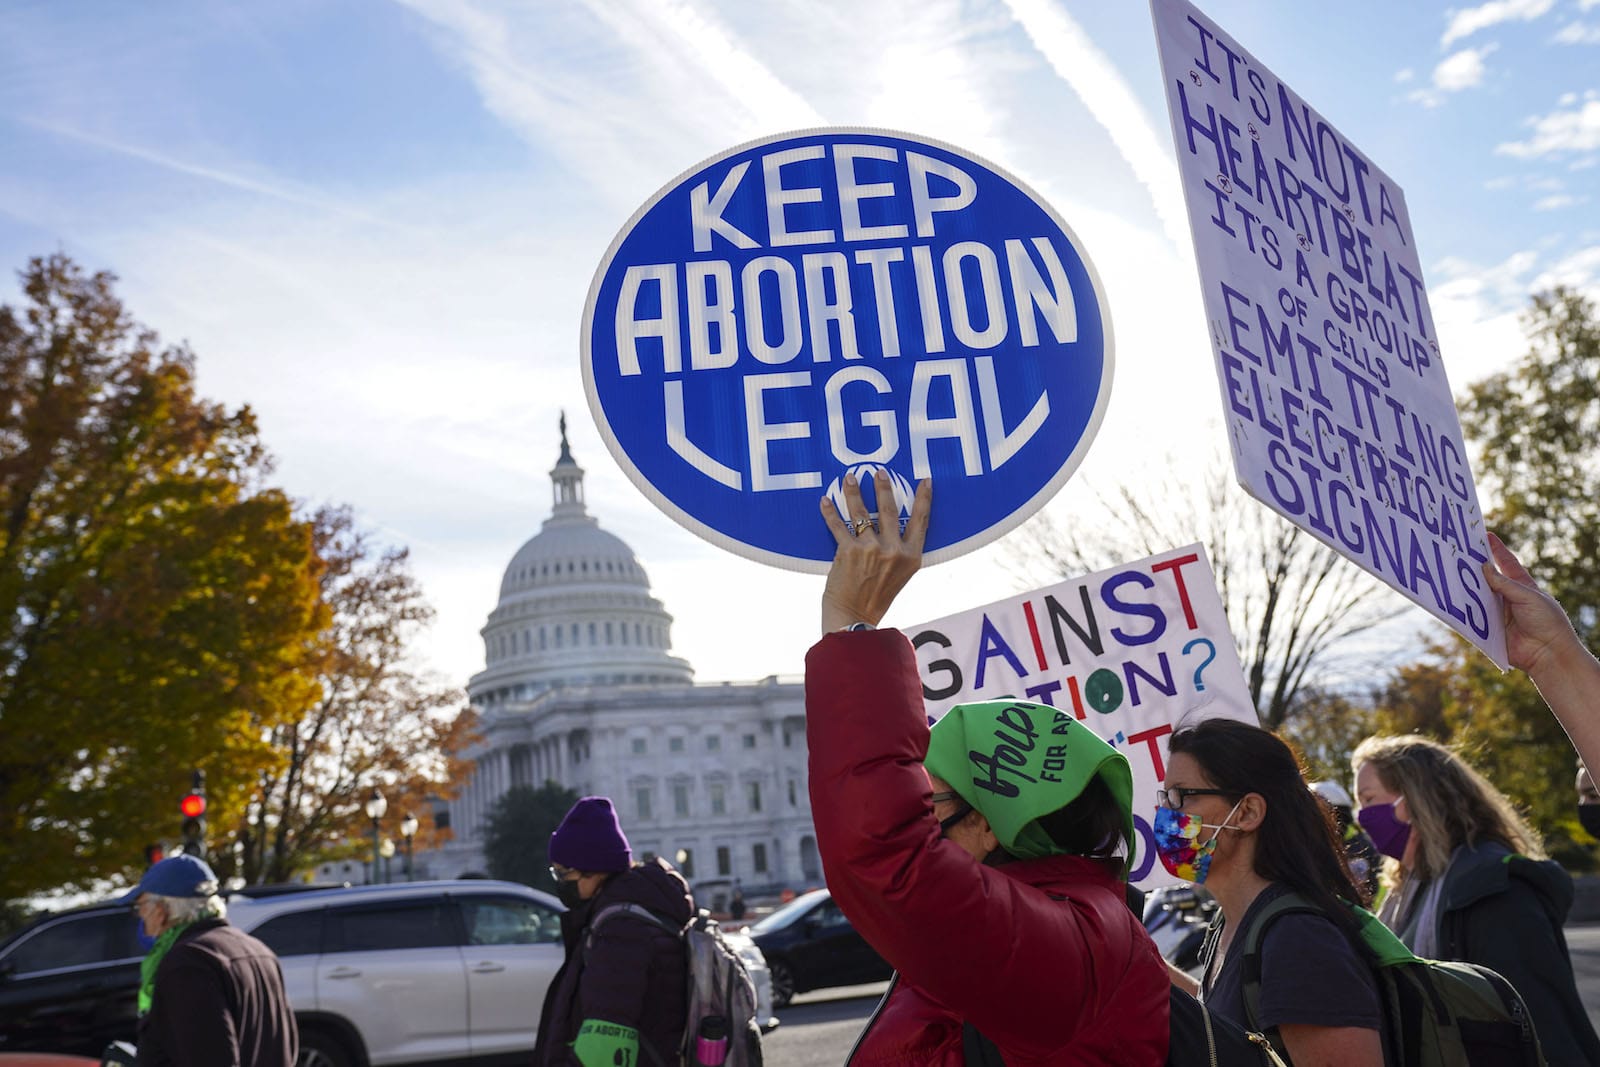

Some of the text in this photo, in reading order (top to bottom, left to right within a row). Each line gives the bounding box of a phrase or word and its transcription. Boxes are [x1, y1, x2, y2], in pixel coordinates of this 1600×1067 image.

[690, 143, 978, 253] KEEP
[1176, 79, 1427, 339] HEARTBEAT
[1187, 15, 1407, 247] IT'S NOT A
[615, 236, 1078, 376] ABORTION
[1203, 178, 1431, 377] IT'S A GROUP
[1278, 287, 1391, 388] OF CELLS
[663, 355, 1051, 493] LEGAL
[1221, 281, 1469, 502] EMITTING
[1221, 350, 1488, 564] ELECTRICAL
[1264, 439, 1490, 641] SIGNALS
[914, 553, 1199, 701] GAINST
[1039, 743, 1068, 784] FOR
